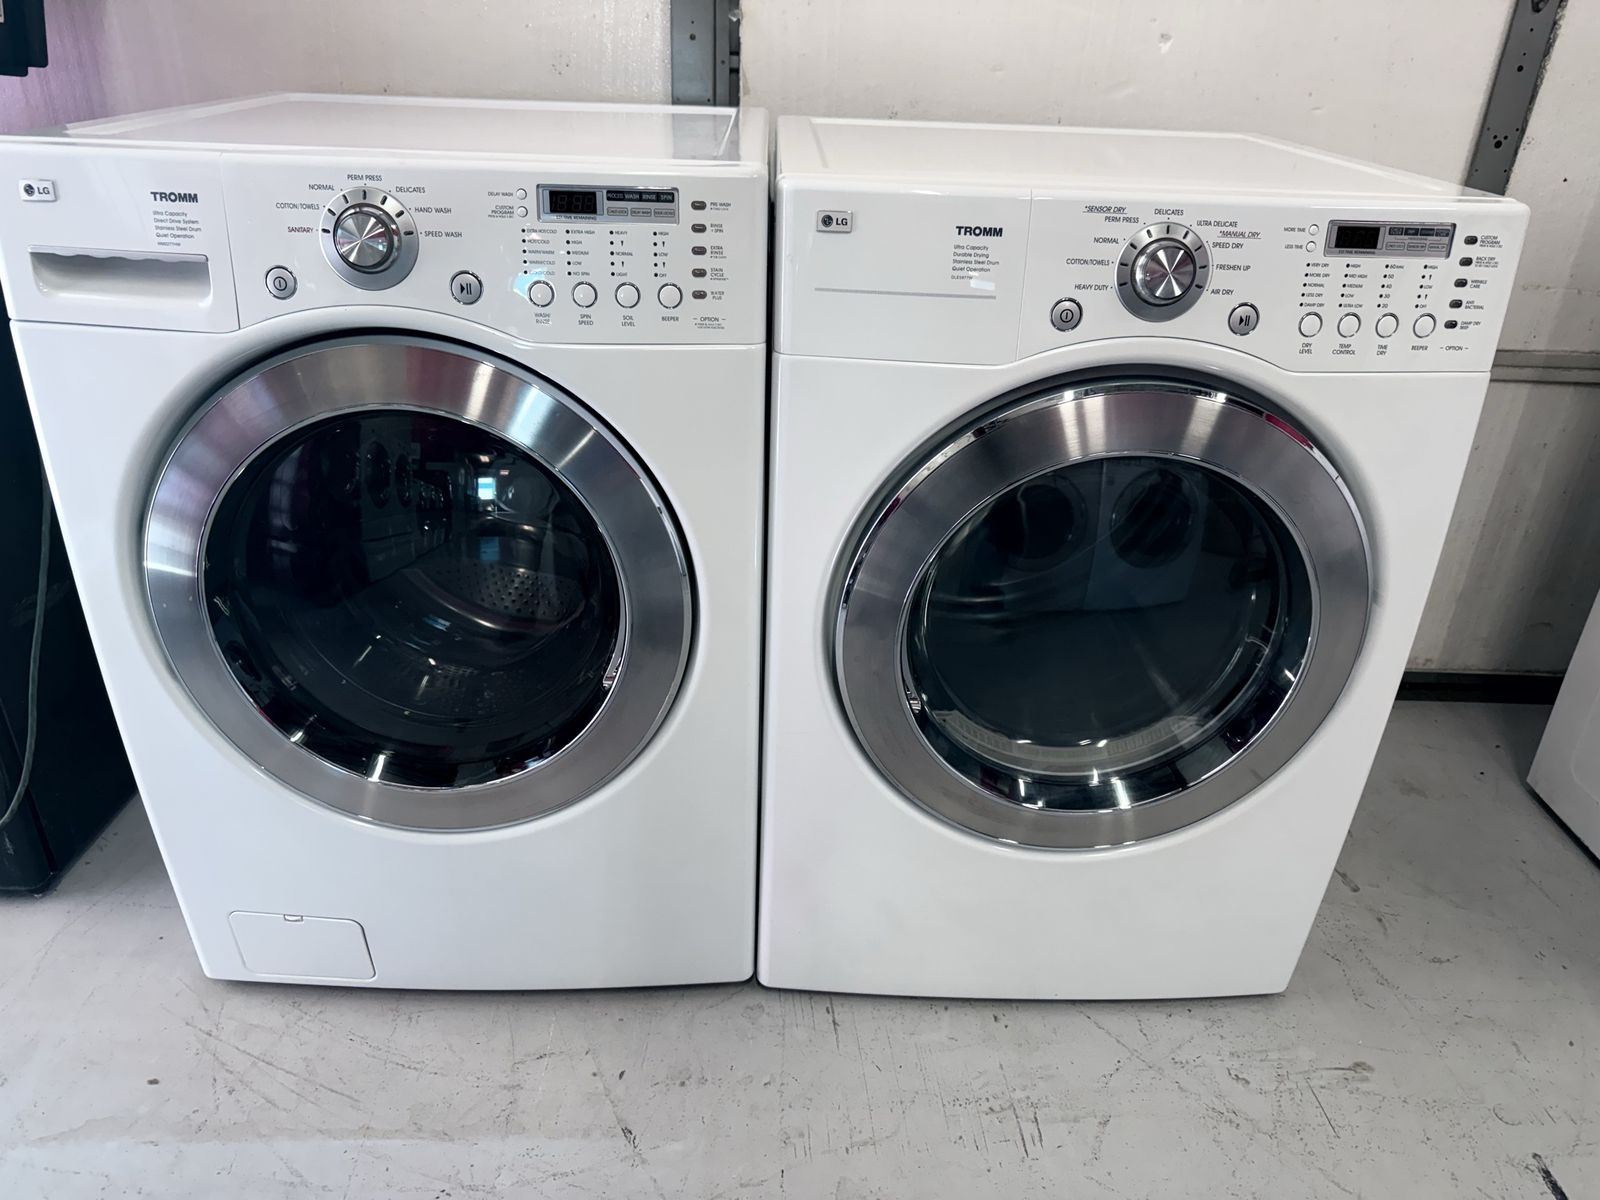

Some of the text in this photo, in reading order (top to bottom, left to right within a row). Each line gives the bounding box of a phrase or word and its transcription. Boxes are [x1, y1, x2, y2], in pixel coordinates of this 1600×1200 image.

[365, 174, 383, 182] PRESS
[395, 186, 426, 194] DELICATES
[150, 191, 199, 203] TROMM
[275, 202, 320, 210] COTTON/TOWELS
[1122, 216, 1139, 224] PRESS
[1213, 220, 1238, 228] DELICATE
[955, 226, 1003, 237] TROMM
[1065, 258, 1110, 266] COTTON/TOWELS
